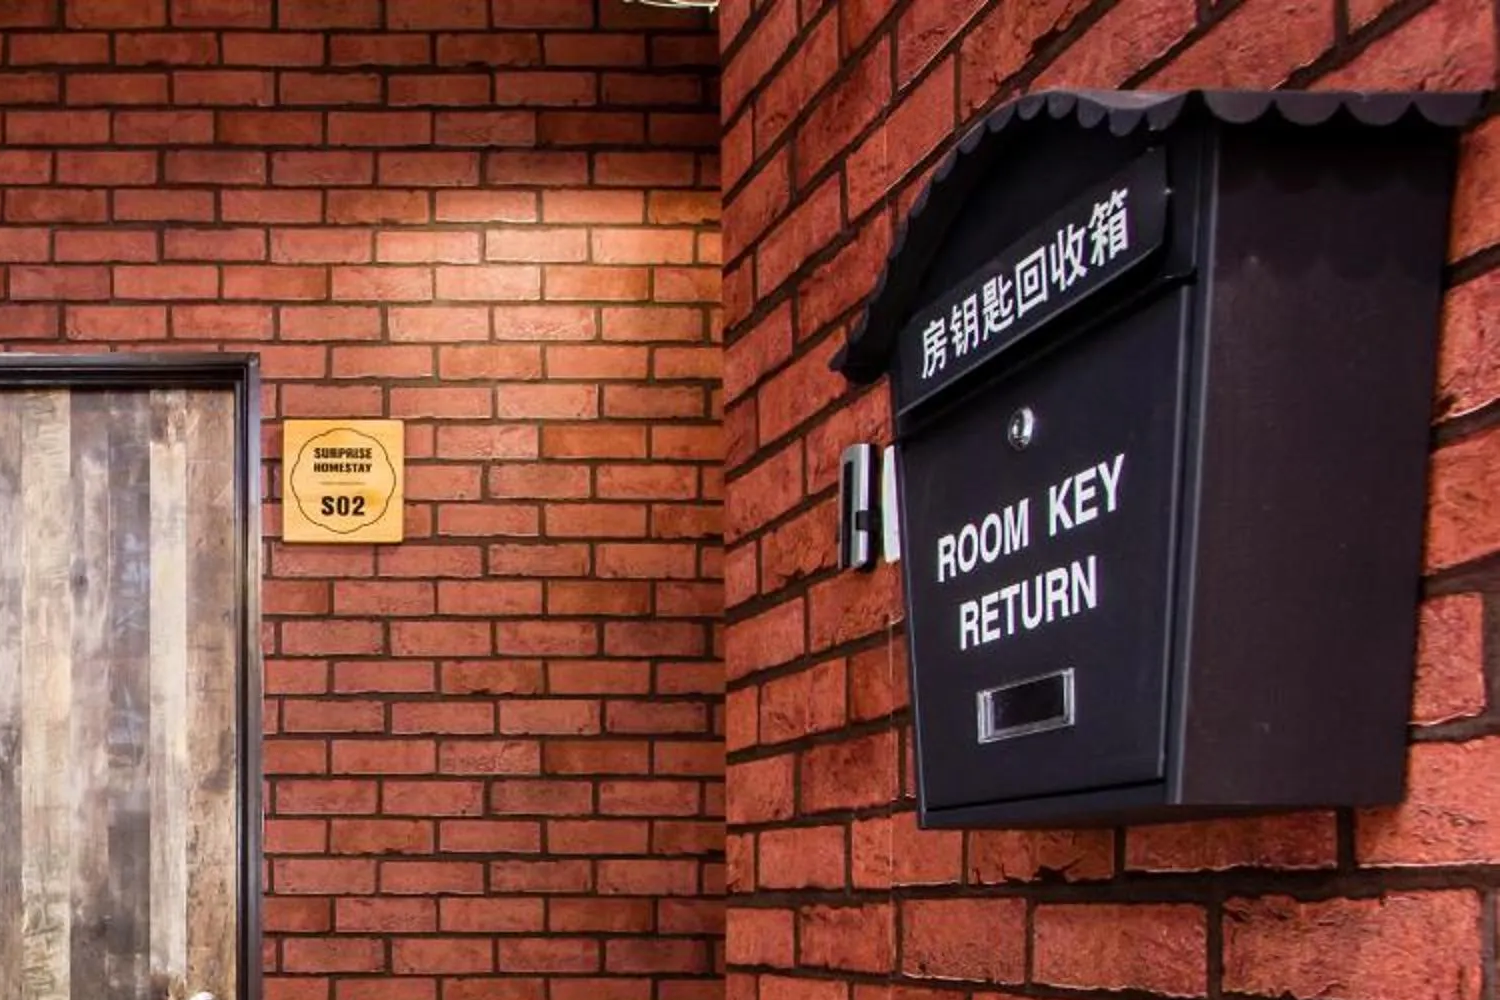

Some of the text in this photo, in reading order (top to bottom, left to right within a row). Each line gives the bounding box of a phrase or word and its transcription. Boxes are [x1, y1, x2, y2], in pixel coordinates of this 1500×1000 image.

[921, 187, 1128, 379] 房钥匙回收箱
[313, 447, 372, 459] SURPRISE
[313, 463, 372, 473] HOMESTAY
[321, 495, 365, 516] S02
[937, 453, 1125, 583] ROOM KEY
[959, 555, 1098, 651] RETURN
